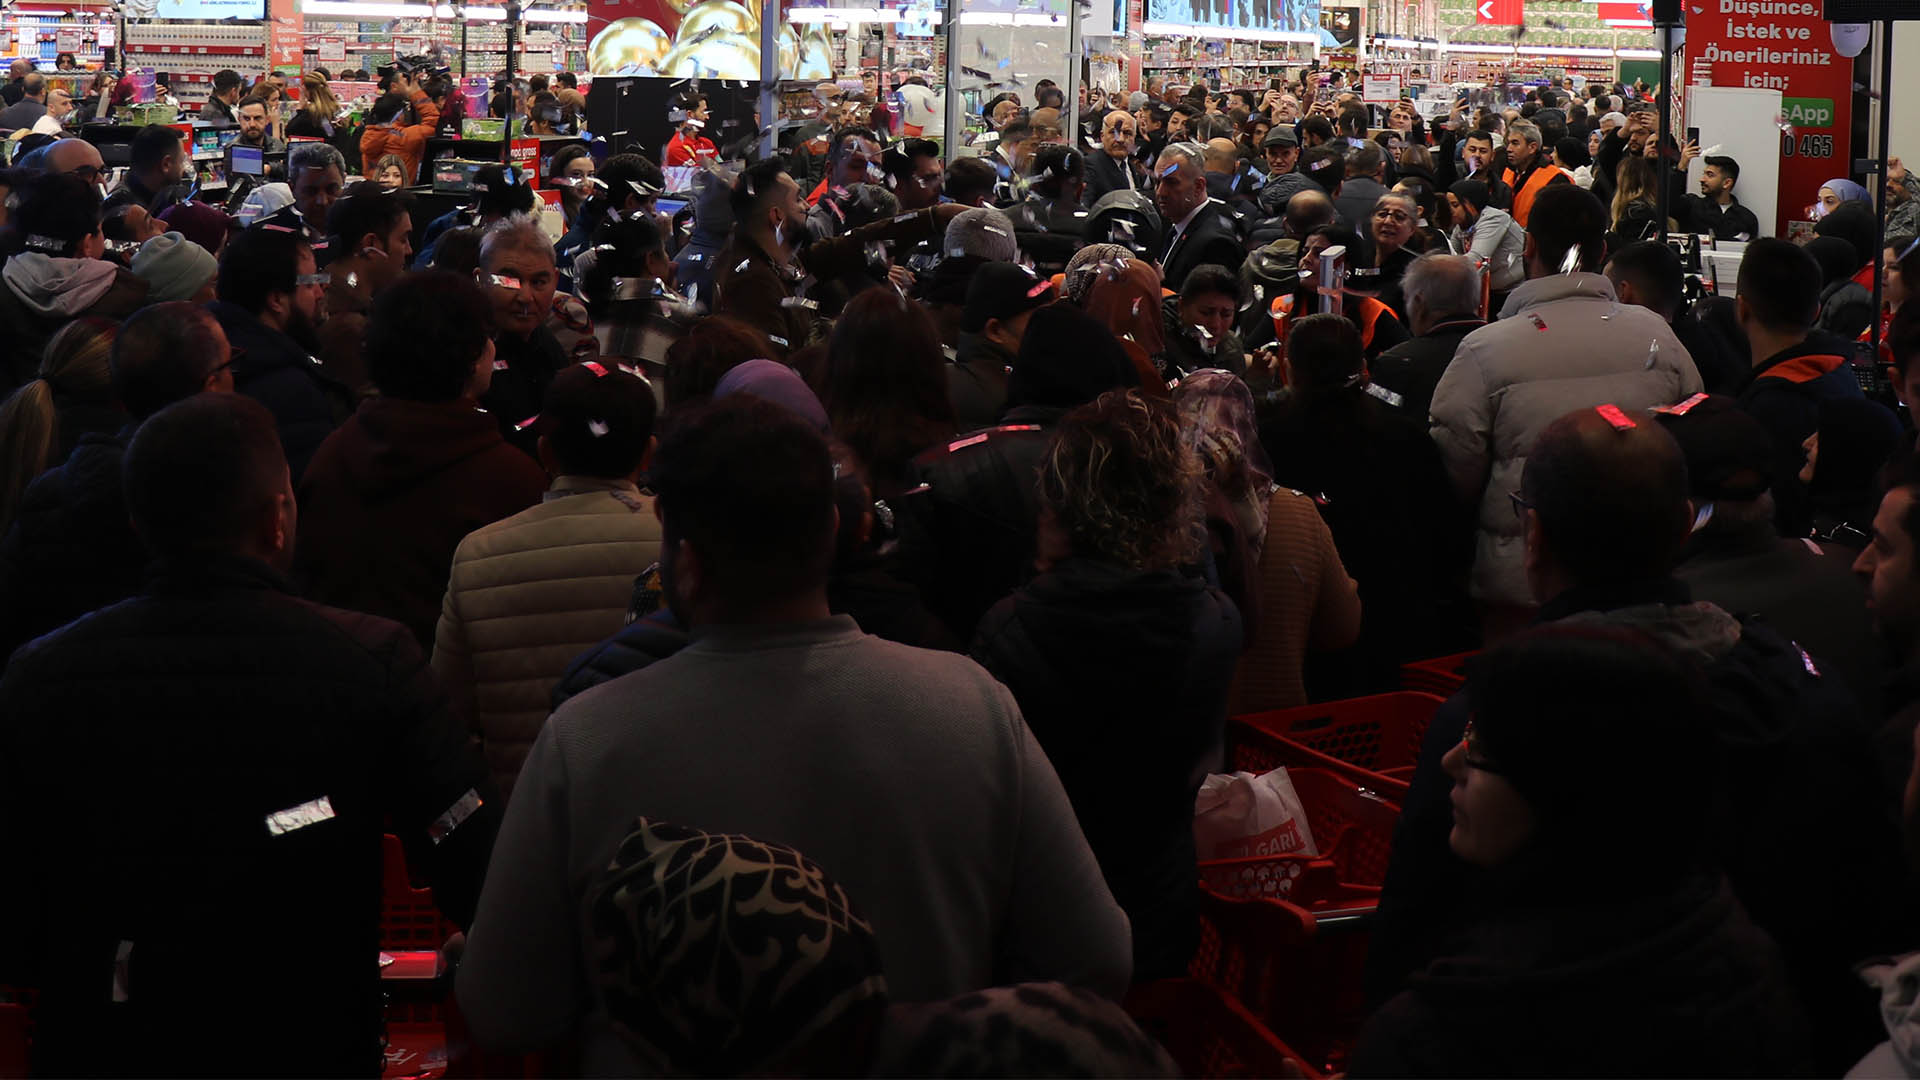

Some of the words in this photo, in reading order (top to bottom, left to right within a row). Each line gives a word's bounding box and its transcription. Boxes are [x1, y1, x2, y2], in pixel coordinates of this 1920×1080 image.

[1720, 0, 1819, 18] Düşünce,
[1727, 18, 1781, 39] İstek
[1785, 27, 1811, 40] ve
[1705, 42, 1831, 65] Önerileriniz
[1782, 104, 1829, 125] sApp
[1799, 134, 1833, 158] 465
